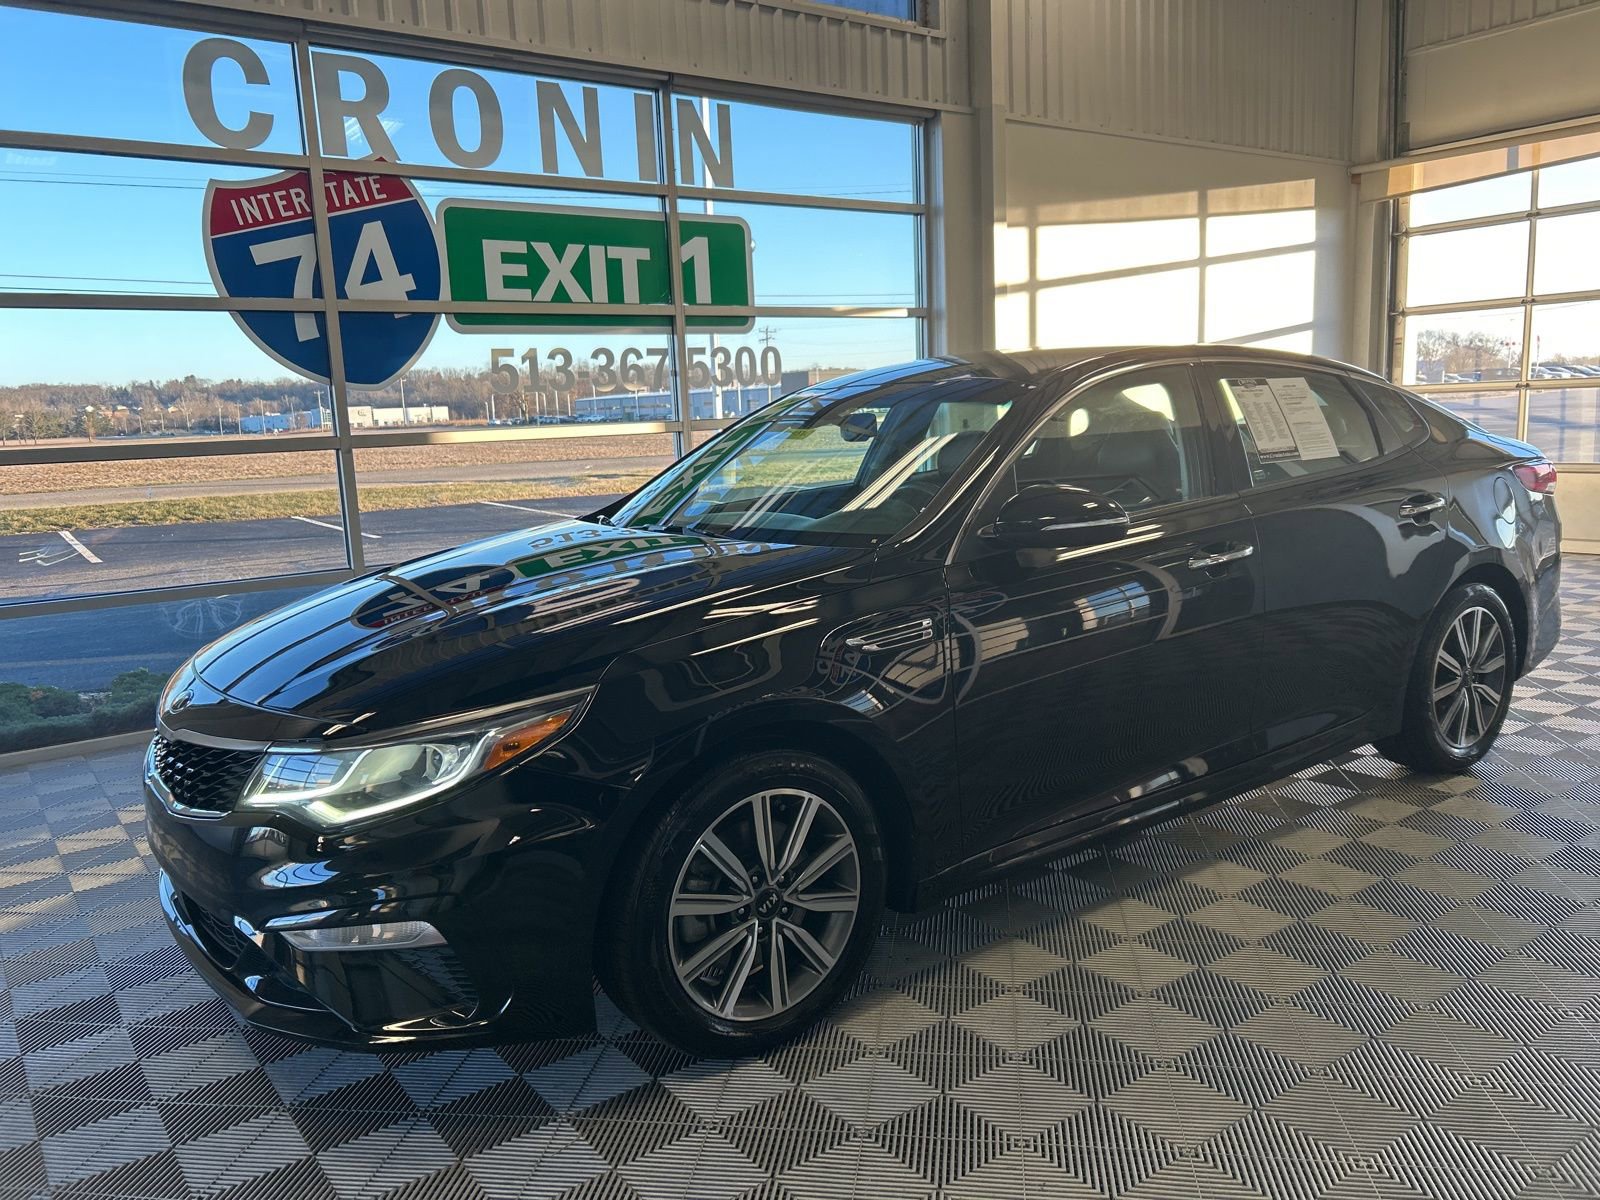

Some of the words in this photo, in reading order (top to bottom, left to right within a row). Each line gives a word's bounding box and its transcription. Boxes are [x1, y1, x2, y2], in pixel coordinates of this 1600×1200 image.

[182, 37, 734, 188] CRONIN
[230, 175, 387, 226] INTERTATE
[249, 220, 417, 342] 74
[482, 239, 650, 304] EXIT
[681, 236, 712, 304] 1
[490, 346, 782, 393] 513-3675300
[758, 893, 778, 914] KIA
